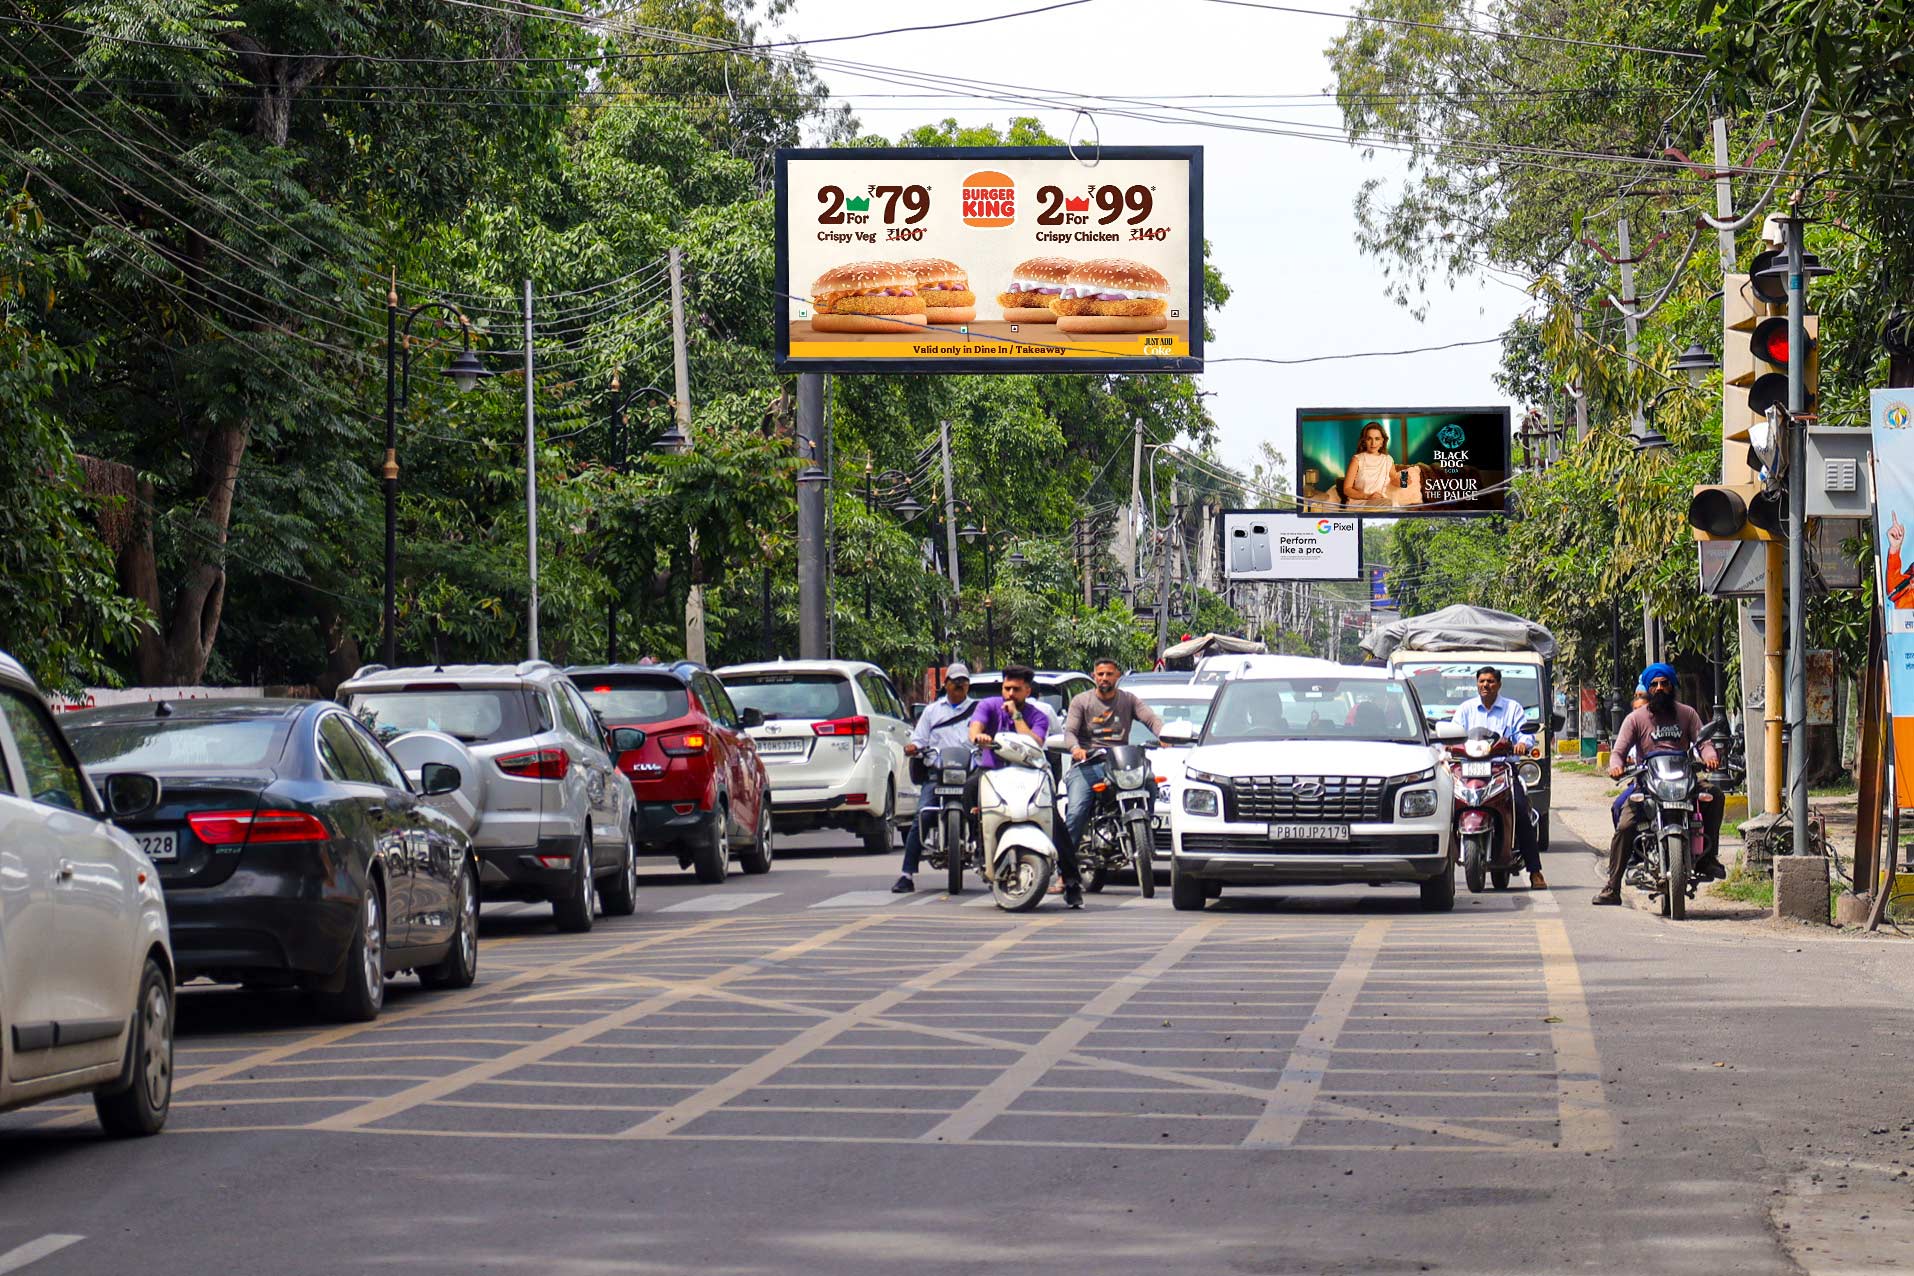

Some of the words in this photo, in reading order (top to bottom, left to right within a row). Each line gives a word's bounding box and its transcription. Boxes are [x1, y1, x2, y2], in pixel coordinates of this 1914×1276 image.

[962, 188, 1015, 200] BURGER
[817, 185, 845, 224] 2
[846, 212, 869, 224] For
[962, 200, 1015, 217] KING
[1036, 185, 1064, 225] 2
[1066, 213, 1089, 225] For
[817, 231, 852, 243] Crispy
[855, 231, 877, 243] Veg
[1035, 231, 1072, 243] Crispy
[1074, 231, 1120, 242] Chicken
[1144, 337, 1159, 346] JUST
[1160, 337, 1173, 346] ADD
[913, 345, 938, 354] Valid
[940, 345, 960, 356] only
[963, 345, 972, 354] in
[974, 345, 996, 354] Dine
[998, 345, 1008, 354] In
[1015, 345, 1066, 356] Takeaway
[1143, 345, 1172, 356] Coke
[1433, 450, 1469, 460] BLACK
[1440, 460, 1464, 468] DOG
[1424, 478, 1478, 490] SAVOUR
[1425, 491, 1441, 499] THE
[1443, 490, 1479, 501] PAUSE
[1333, 522, 1354, 531] Pixel
[1280, 536, 1317, 545] Perform
[1280, 546, 1296, 554] like
[1306, 547, 1324, 555] pro.
[1277, 826, 1347, 839] PB10JP2179
